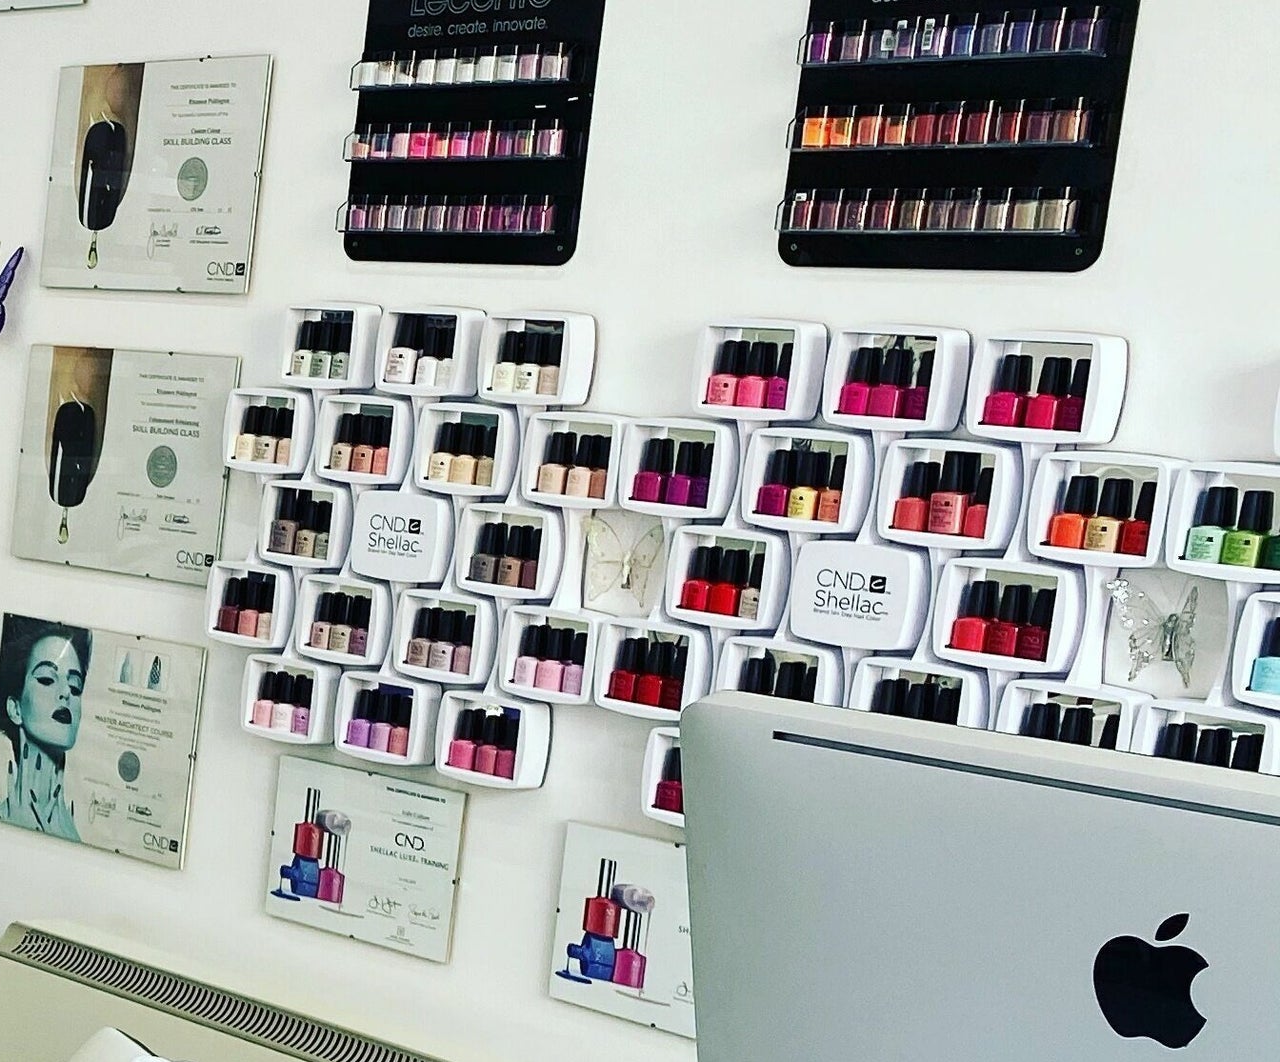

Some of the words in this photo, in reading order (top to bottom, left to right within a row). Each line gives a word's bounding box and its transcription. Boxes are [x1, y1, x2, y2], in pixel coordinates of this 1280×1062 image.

[447, 19, 488, 35] create.
[493, 16, 548, 32] innovate.
[207, 261, 235, 276] CND
[370, 514, 406, 533] CND
[368, 531, 420, 553] Shellac
[176, 550, 204, 567] CND
[817, 568, 866, 591] CND
[814, 589, 884, 615] Shellac
[143, 831, 169, 850] CND
[395, 832, 425, 851] CND
